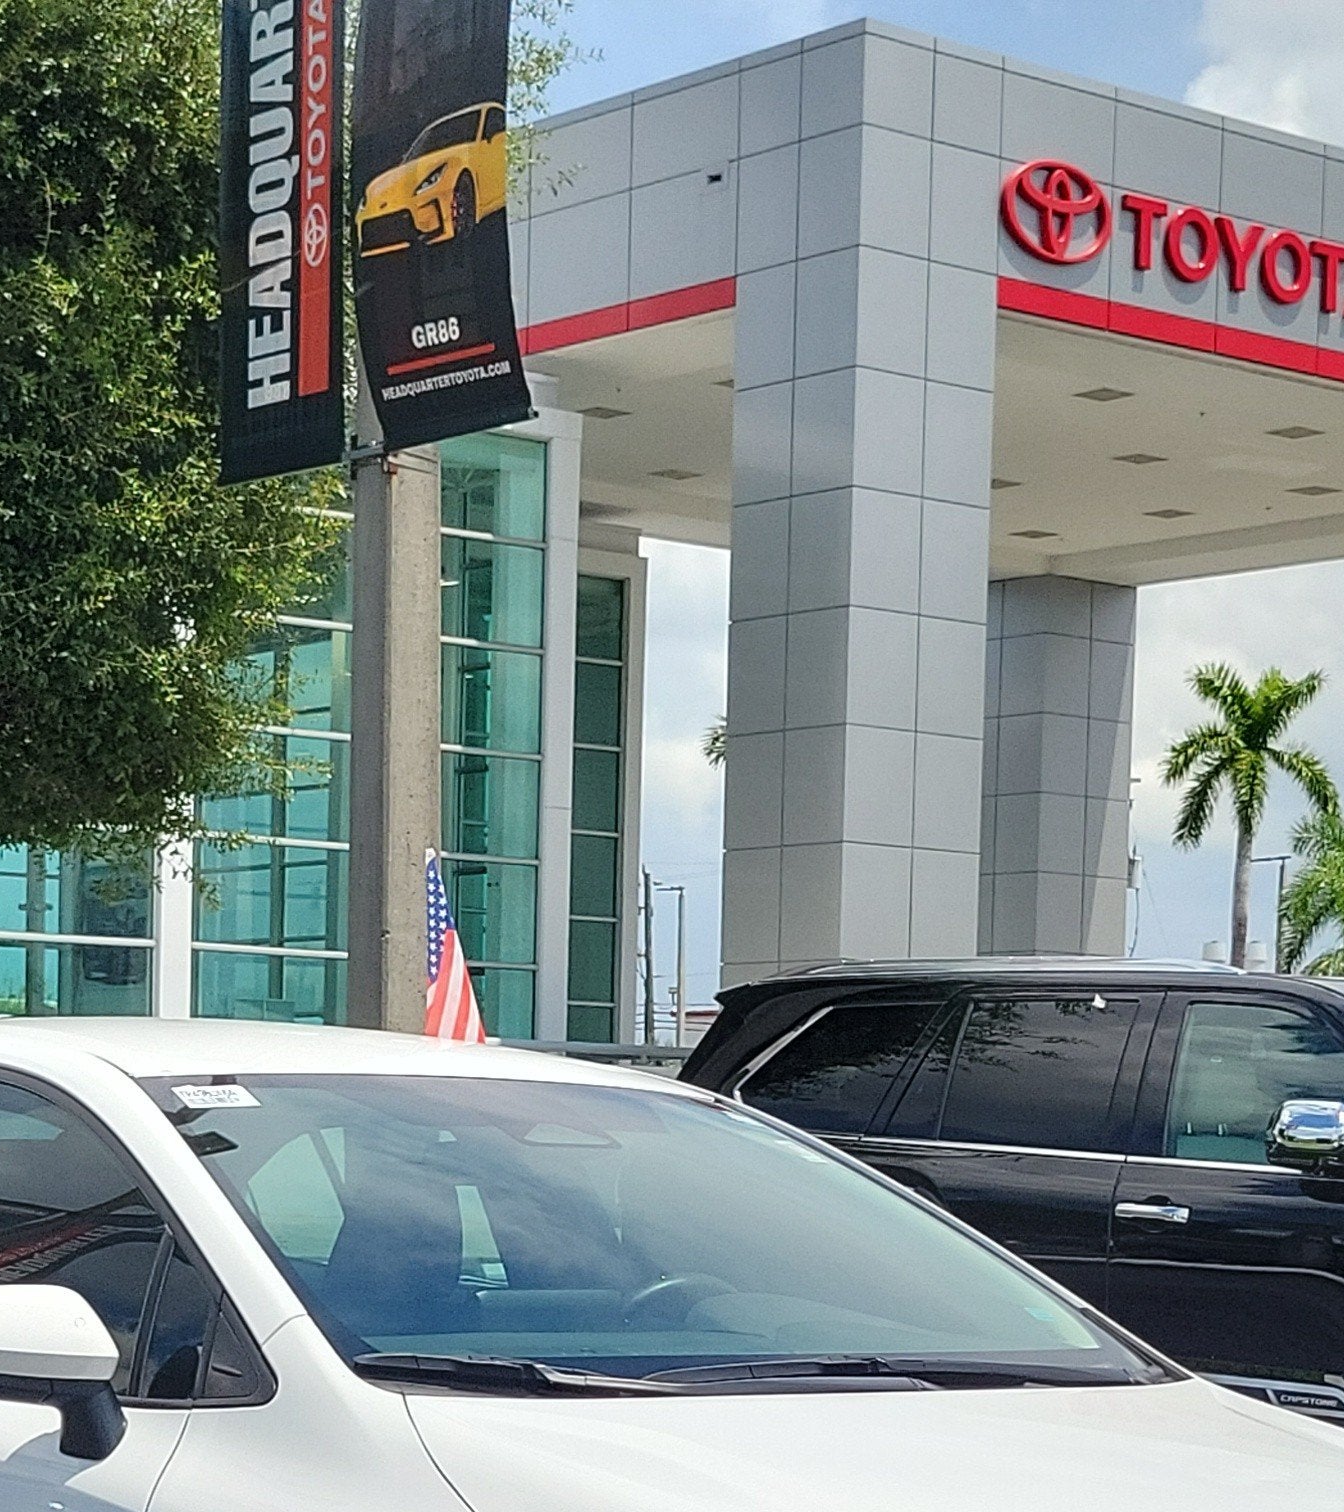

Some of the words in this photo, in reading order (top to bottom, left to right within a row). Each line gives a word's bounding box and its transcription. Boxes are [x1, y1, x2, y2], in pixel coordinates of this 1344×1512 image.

[247, 0, 299, 410] HEADQUAR
[411, 316, 461, 349] GR86
[381, 360, 512, 401] HEADQUARTERTOYOTA.COM
